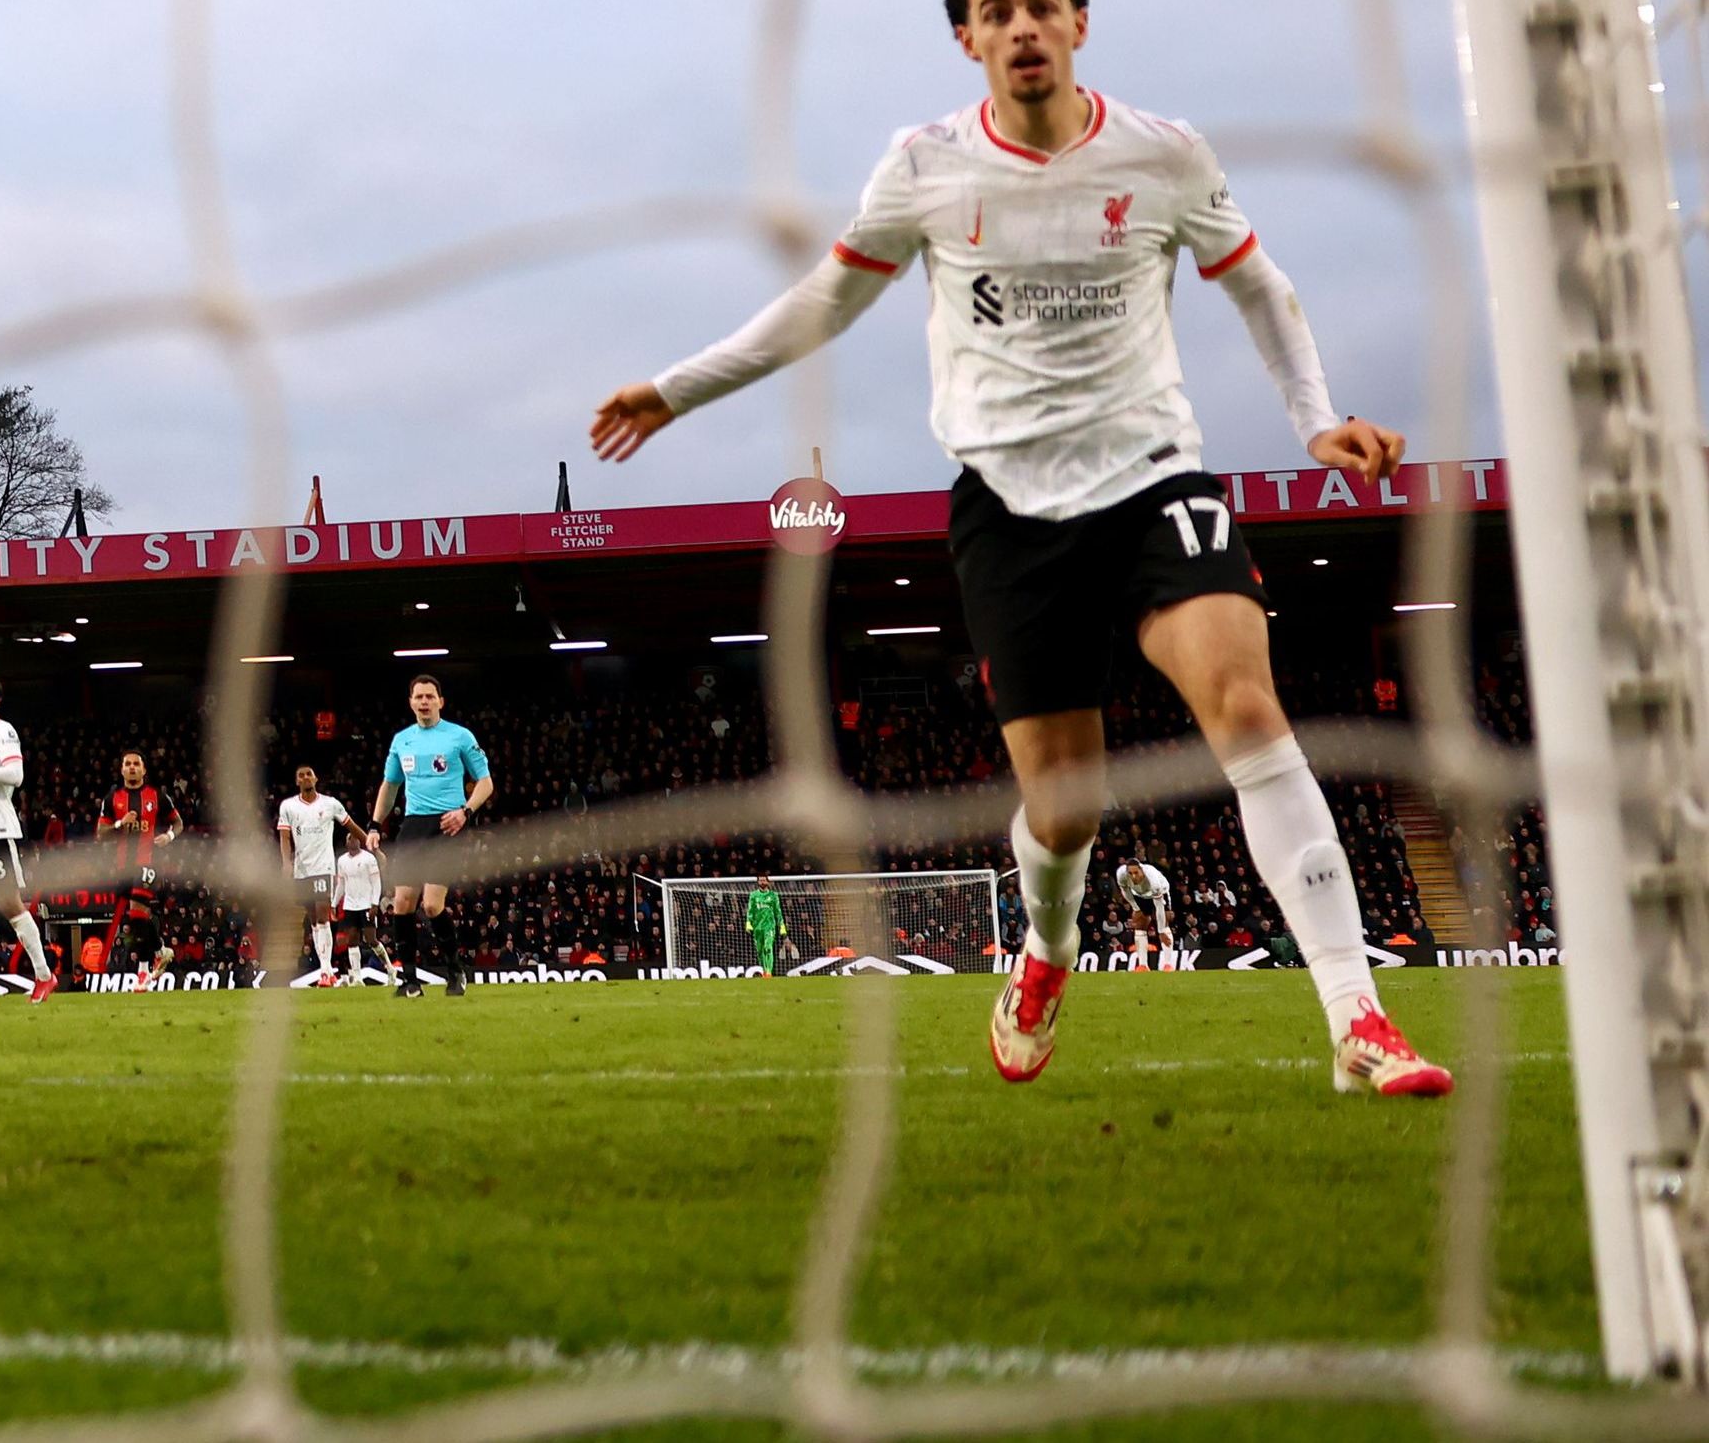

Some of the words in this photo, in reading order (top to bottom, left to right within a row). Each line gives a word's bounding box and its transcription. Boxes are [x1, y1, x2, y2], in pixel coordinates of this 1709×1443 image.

[1012, 281, 1121, 302] standard
[1013, 300, 1127, 321] chartered
[1231, 460, 1496, 513] ITALIT
[562, 513, 602, 525] STEVE
[769, 497, 846, 535] Vitality
[550, 524, 614, 537] FLETCHER
[1162, 496, 1231, 558] 17
[142, 518, 468, 572] STADIUM
[562, 536, 605, 548] STAND
[141, 866, 156, 885] 19
[474, 963, 608, 985] umbro
